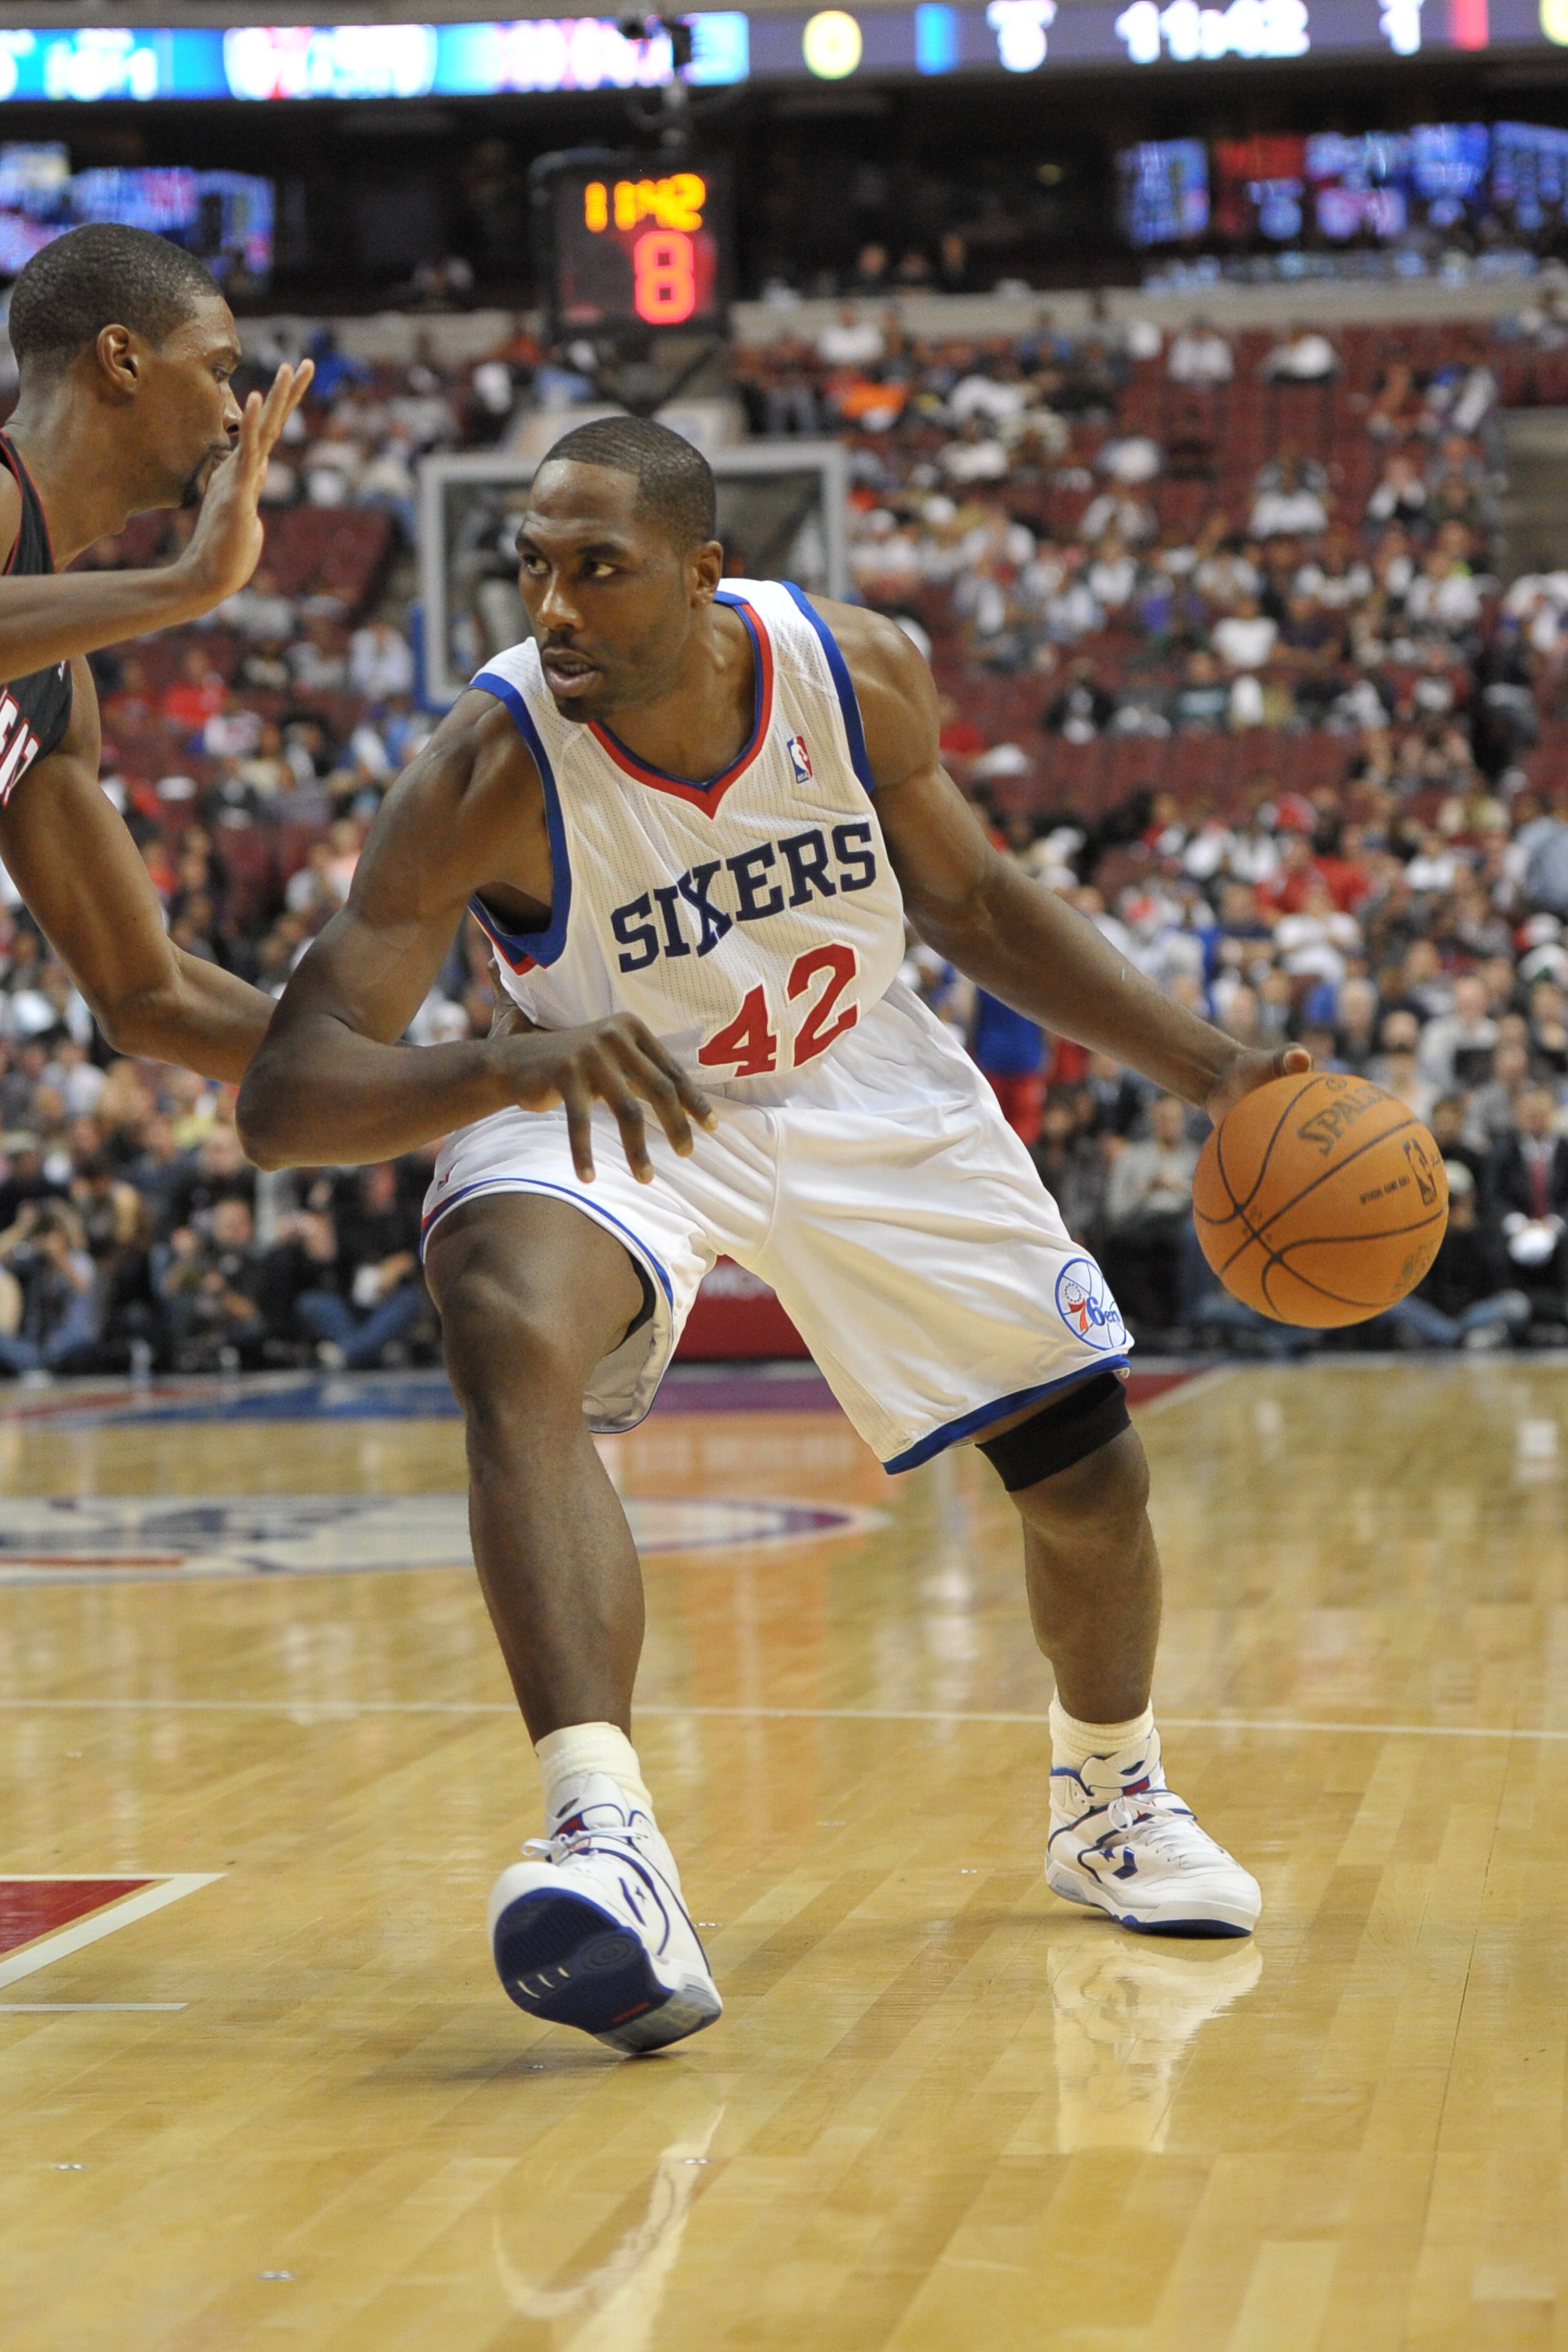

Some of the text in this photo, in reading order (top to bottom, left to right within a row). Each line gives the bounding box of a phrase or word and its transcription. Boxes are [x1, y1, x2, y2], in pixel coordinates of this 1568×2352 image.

[633, 230, 695, 324] 8
[610, 822, 876, 973] SIXERS
[697, 941, 858, 1078] 42
